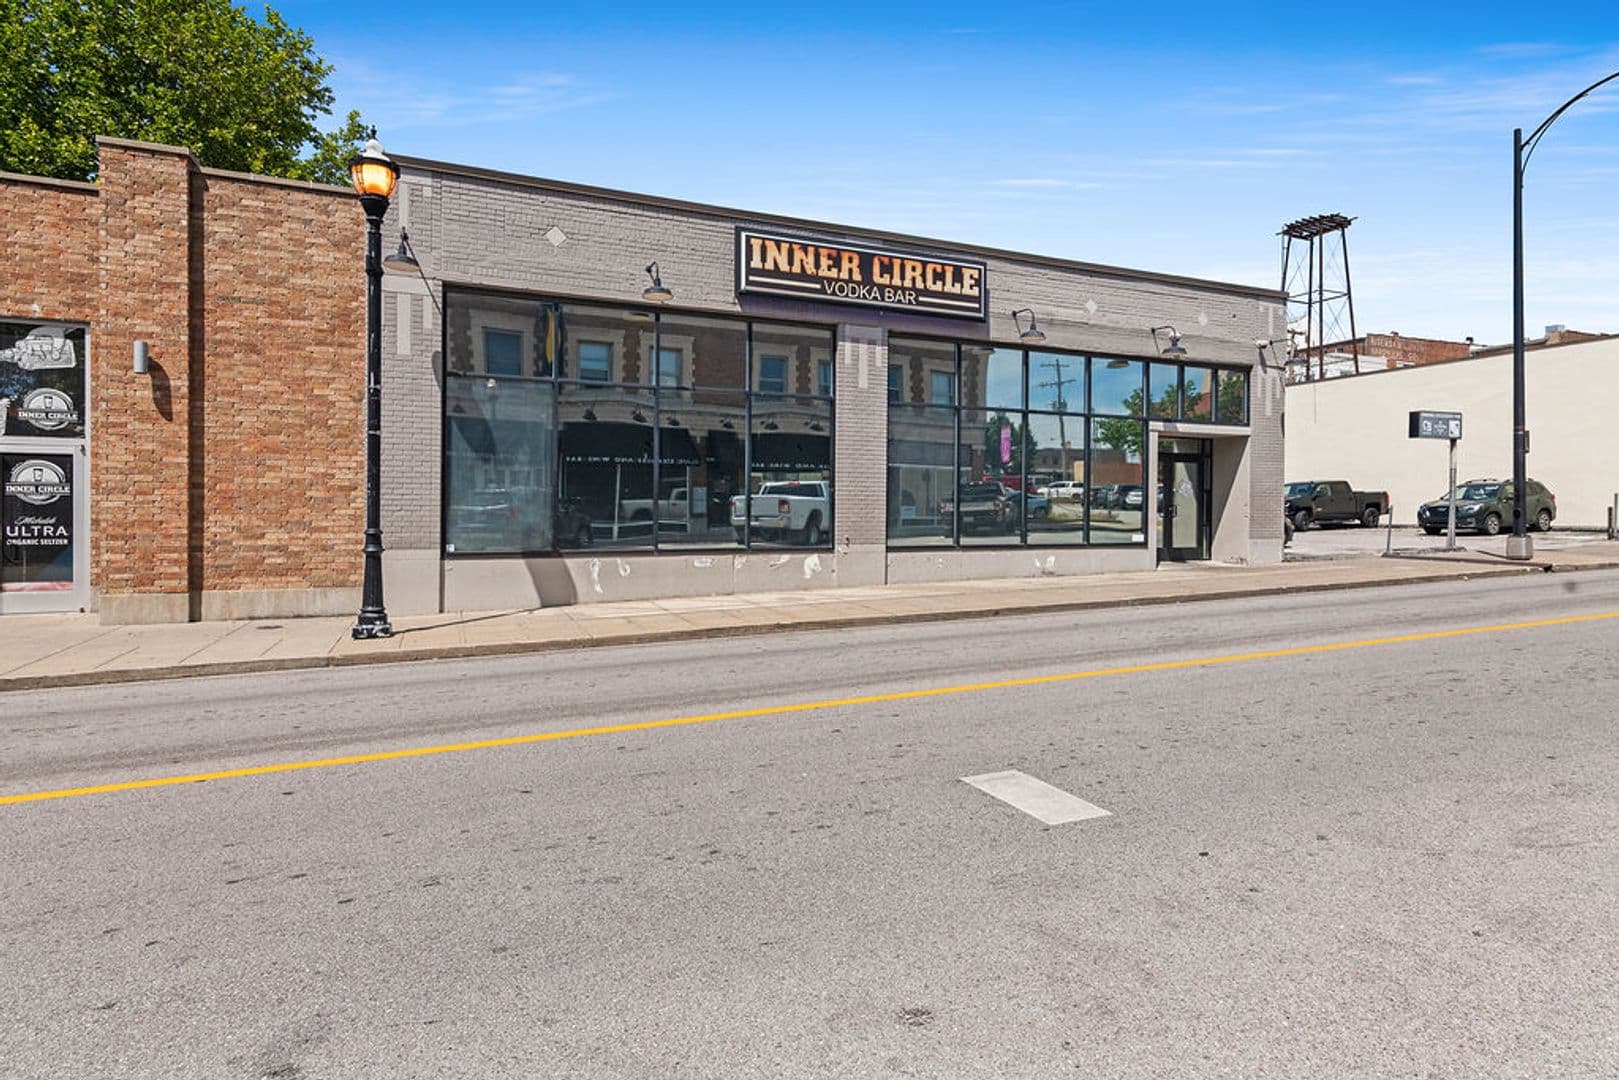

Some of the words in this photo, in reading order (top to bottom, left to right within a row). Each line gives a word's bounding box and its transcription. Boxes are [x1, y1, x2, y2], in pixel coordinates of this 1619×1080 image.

[750, 238, 862, 281] INNER
[872, 256, 979, 296] CIRCLE
[823, 279, 881, 301] VODKA
[884, 287, 917, 305] BAR
[18, 411, 46, 419] INNER
[47, 412, 78, 420] CIRCLE
[5, 485, 35, 493] INNER
[38, 485, 70, 493] CIRCLE
[6, 526, 69, 537] ULTRA
